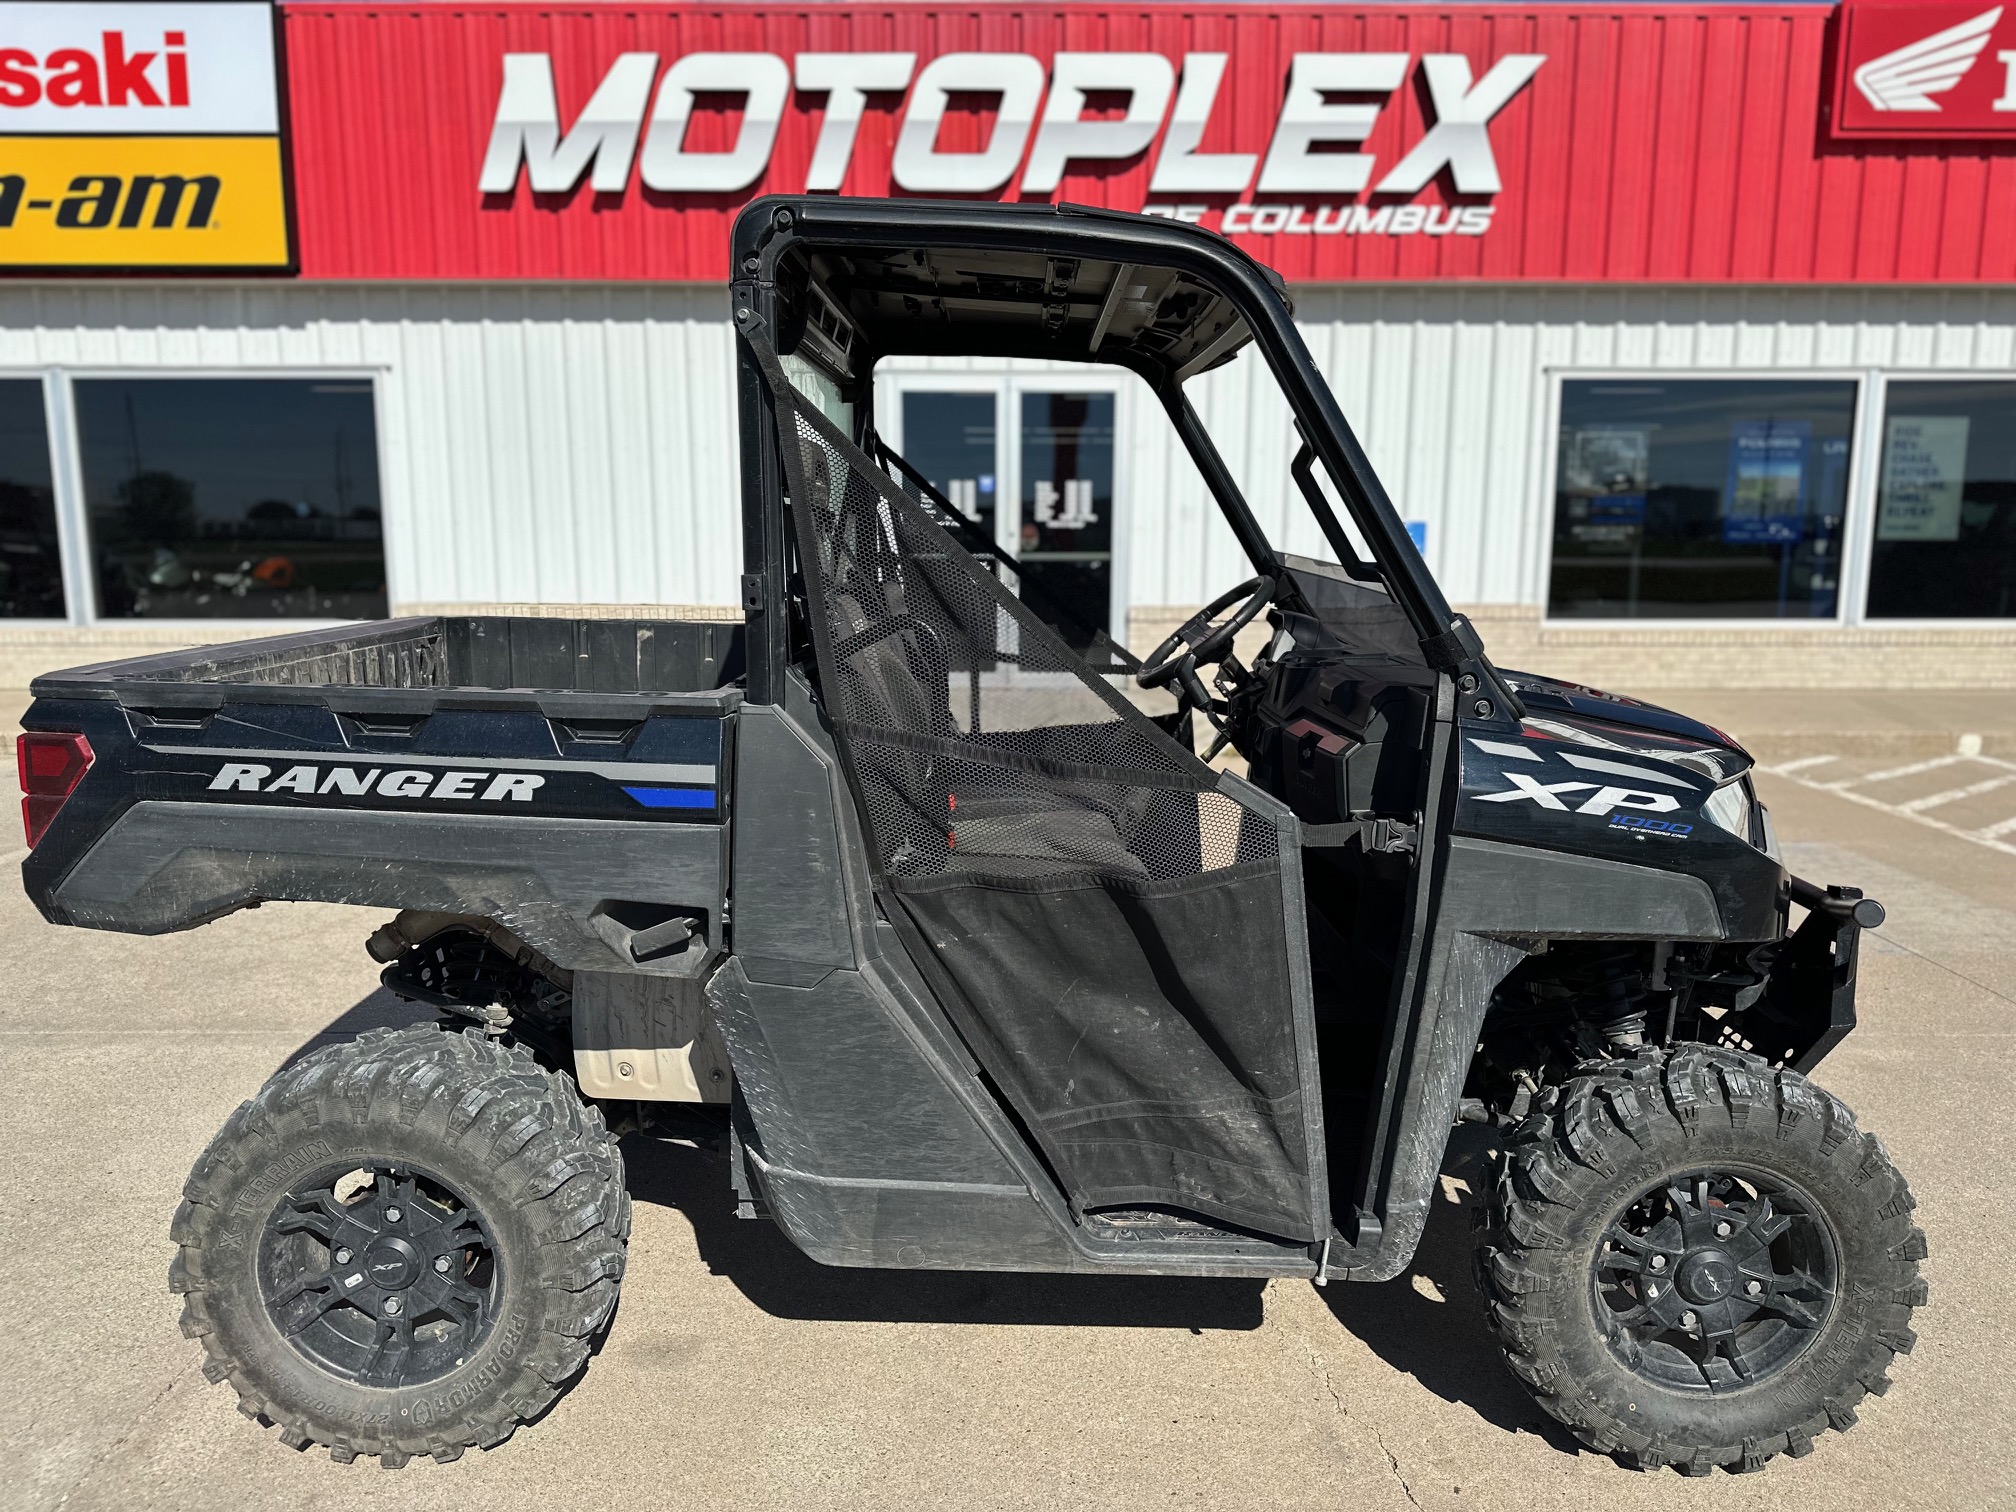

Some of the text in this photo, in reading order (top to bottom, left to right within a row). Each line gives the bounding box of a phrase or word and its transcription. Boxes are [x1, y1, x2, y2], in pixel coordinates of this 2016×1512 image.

[0, 31, 190, 107] saki
[478, 52, 1548, 194] MOTOPLEX
[1220, 204, 1495, 235] COLUMBUS
[206, 763, 546, 802] RANGER
[1470, 771, 1682, 816] XP
[1608, 823, 1629, 831] DUAL
[1630, 827, 1671, 837] OVERHEAD
[1610, 813, 1693, 834] 1000
[218, 1140, 334, 1249] X-TERRAIN
[372, 1262, 403, 1271] XP
[1704, 1268, 1721, 1294] XP
[434, 1312, 526, 1415] PRO ARMOR
[1774, 1282, 1876, 1412] X-TERRAIN
